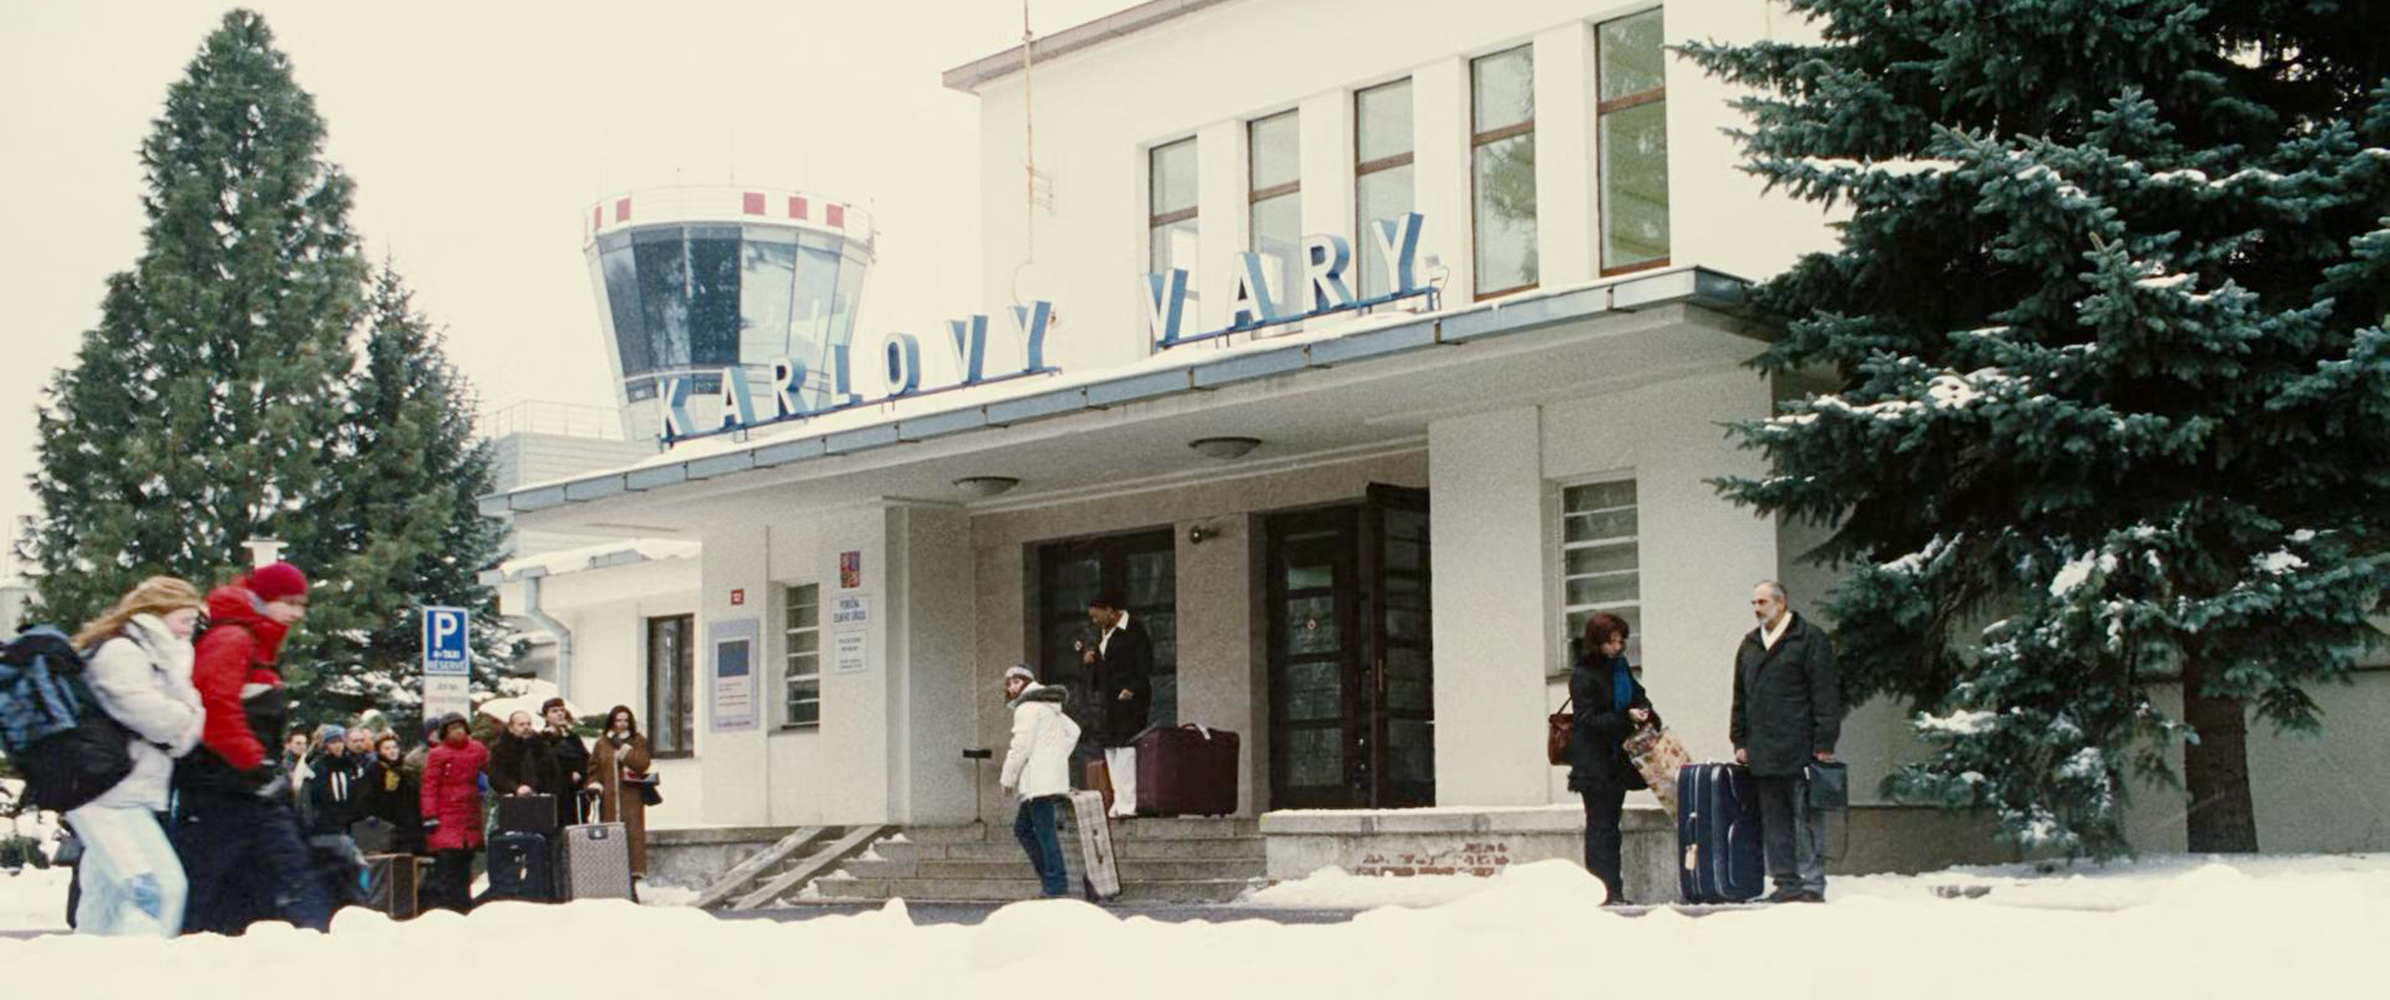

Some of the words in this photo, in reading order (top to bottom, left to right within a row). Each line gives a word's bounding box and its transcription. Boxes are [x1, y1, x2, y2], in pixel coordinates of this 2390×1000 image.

[657, 301, 1052, 441] KARLOVY
[1141, 211, 1424, 344] VARY
[434, 612, 458, 649] P
